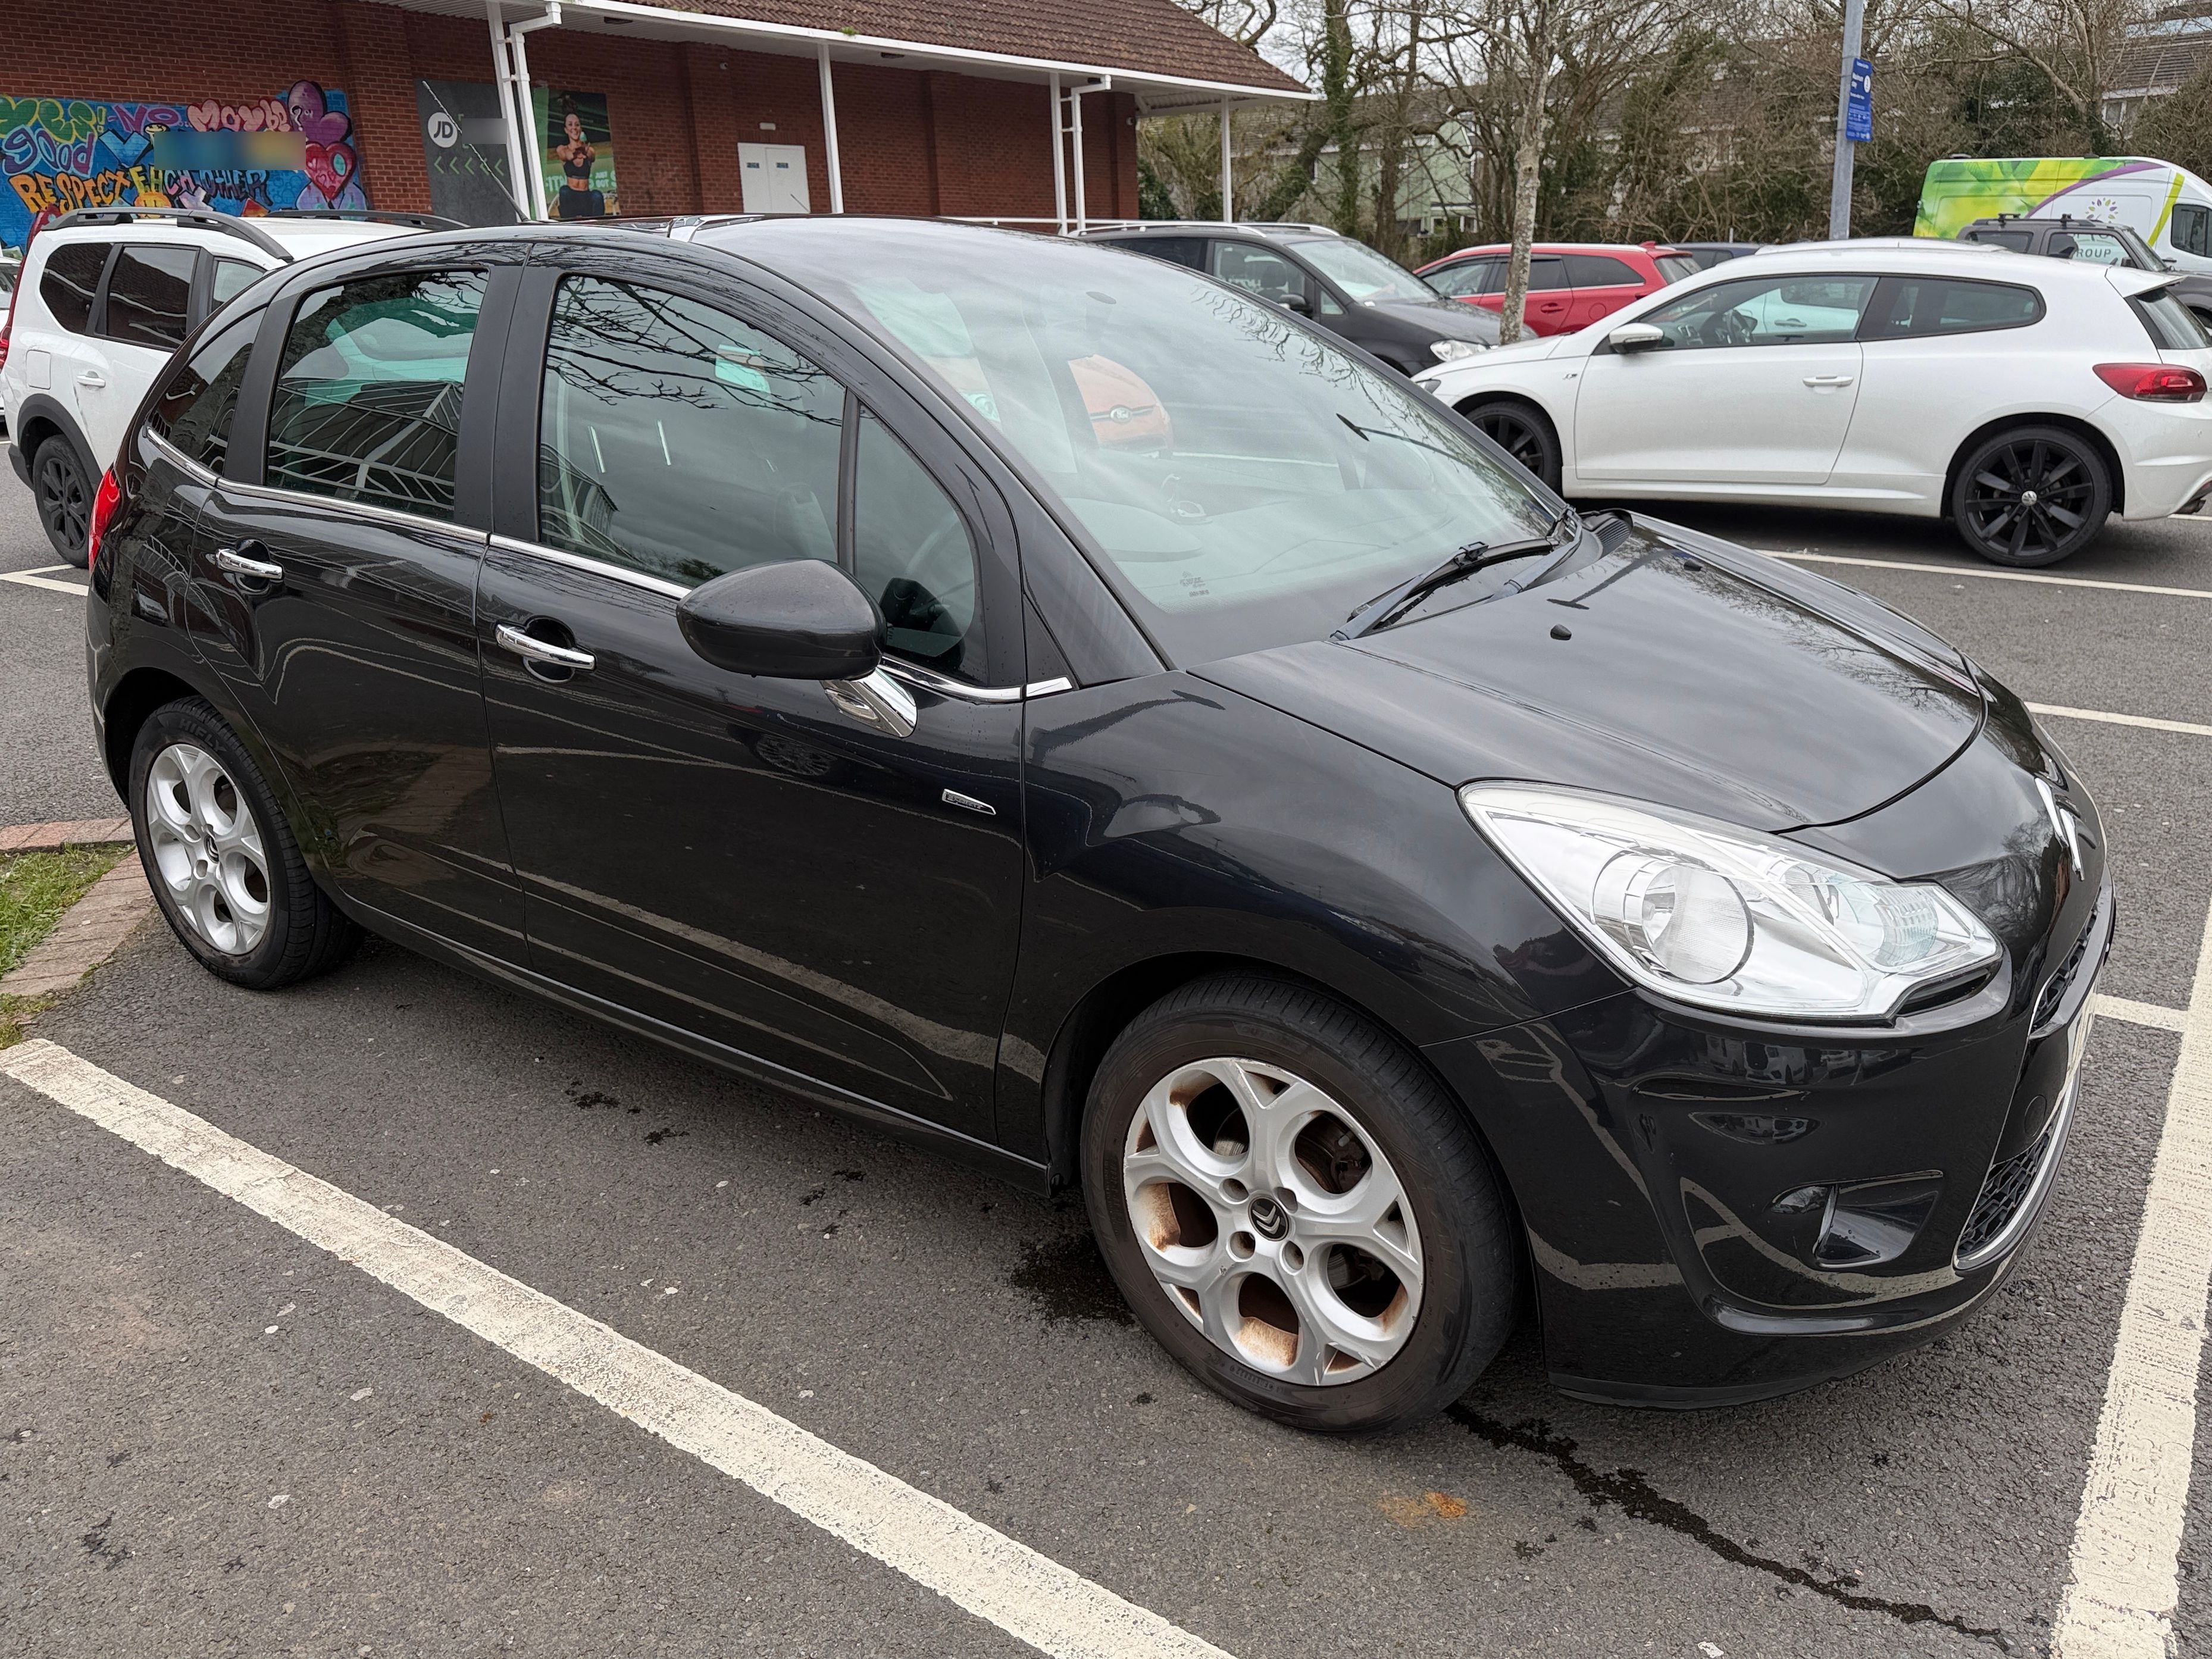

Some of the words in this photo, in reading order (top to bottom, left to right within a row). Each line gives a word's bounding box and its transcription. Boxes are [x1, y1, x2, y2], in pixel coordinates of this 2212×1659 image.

[433, 121, 453, 139] JD
[2, 124, 98, 177] good
[8, 169, 132, 214] RESPECT
[2076, 248, 2112, 258] ROUP
[179, 718, 227, 752] HIFLY
